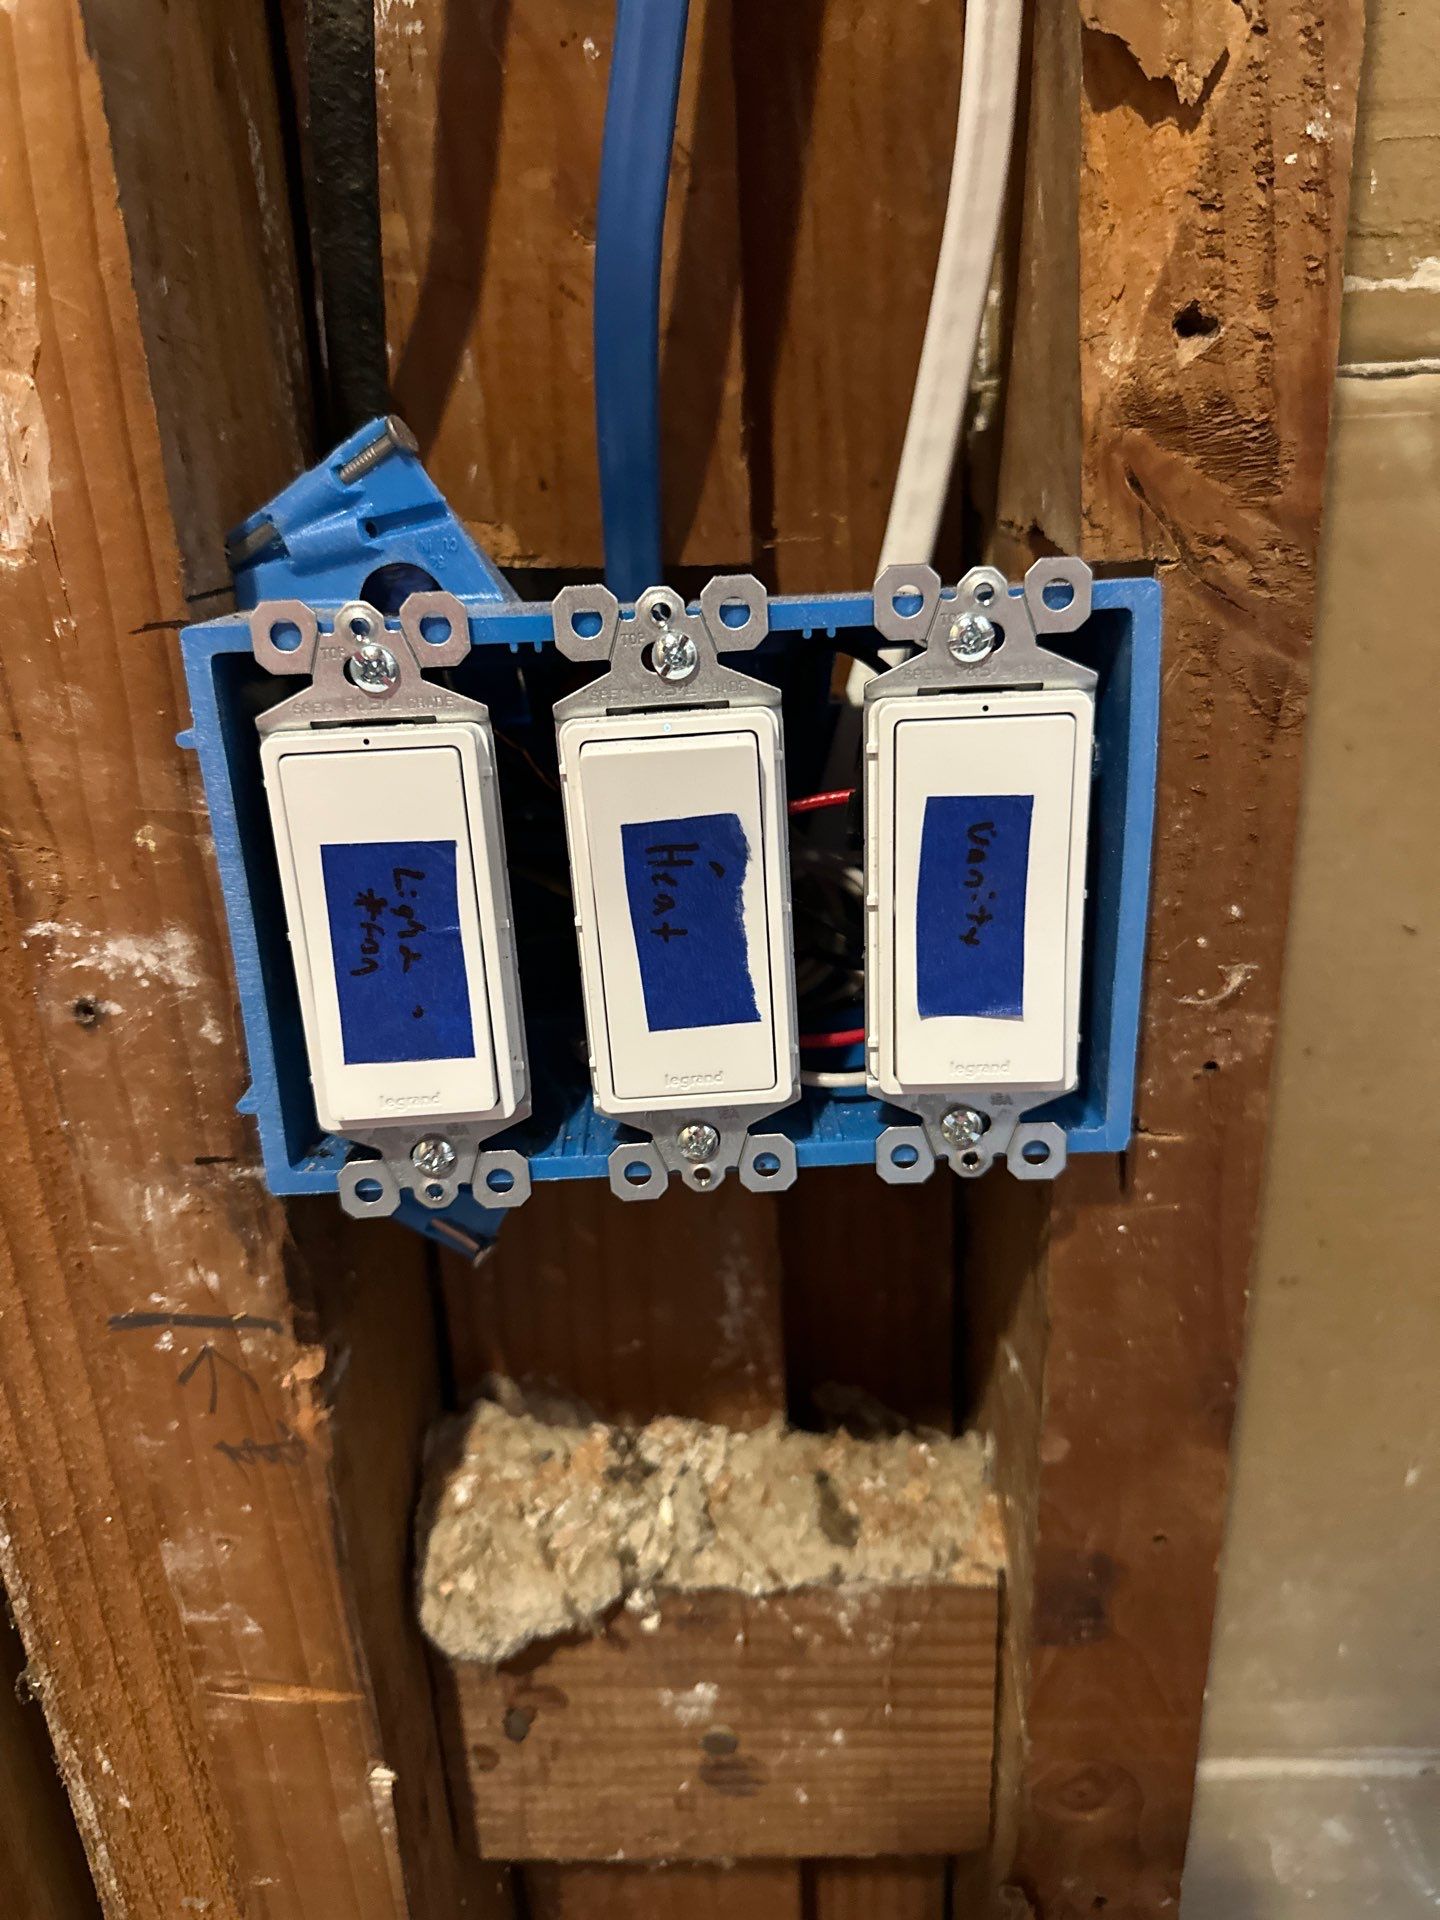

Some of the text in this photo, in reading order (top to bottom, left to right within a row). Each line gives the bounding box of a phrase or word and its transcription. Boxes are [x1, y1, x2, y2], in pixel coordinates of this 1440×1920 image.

[644, 843, 700, 944] Heat
[949, 1058, 1010, 1078] legrand
[664, 1069, 724, 1090] legrand
[379, 1090, 441, 1110] legrand
